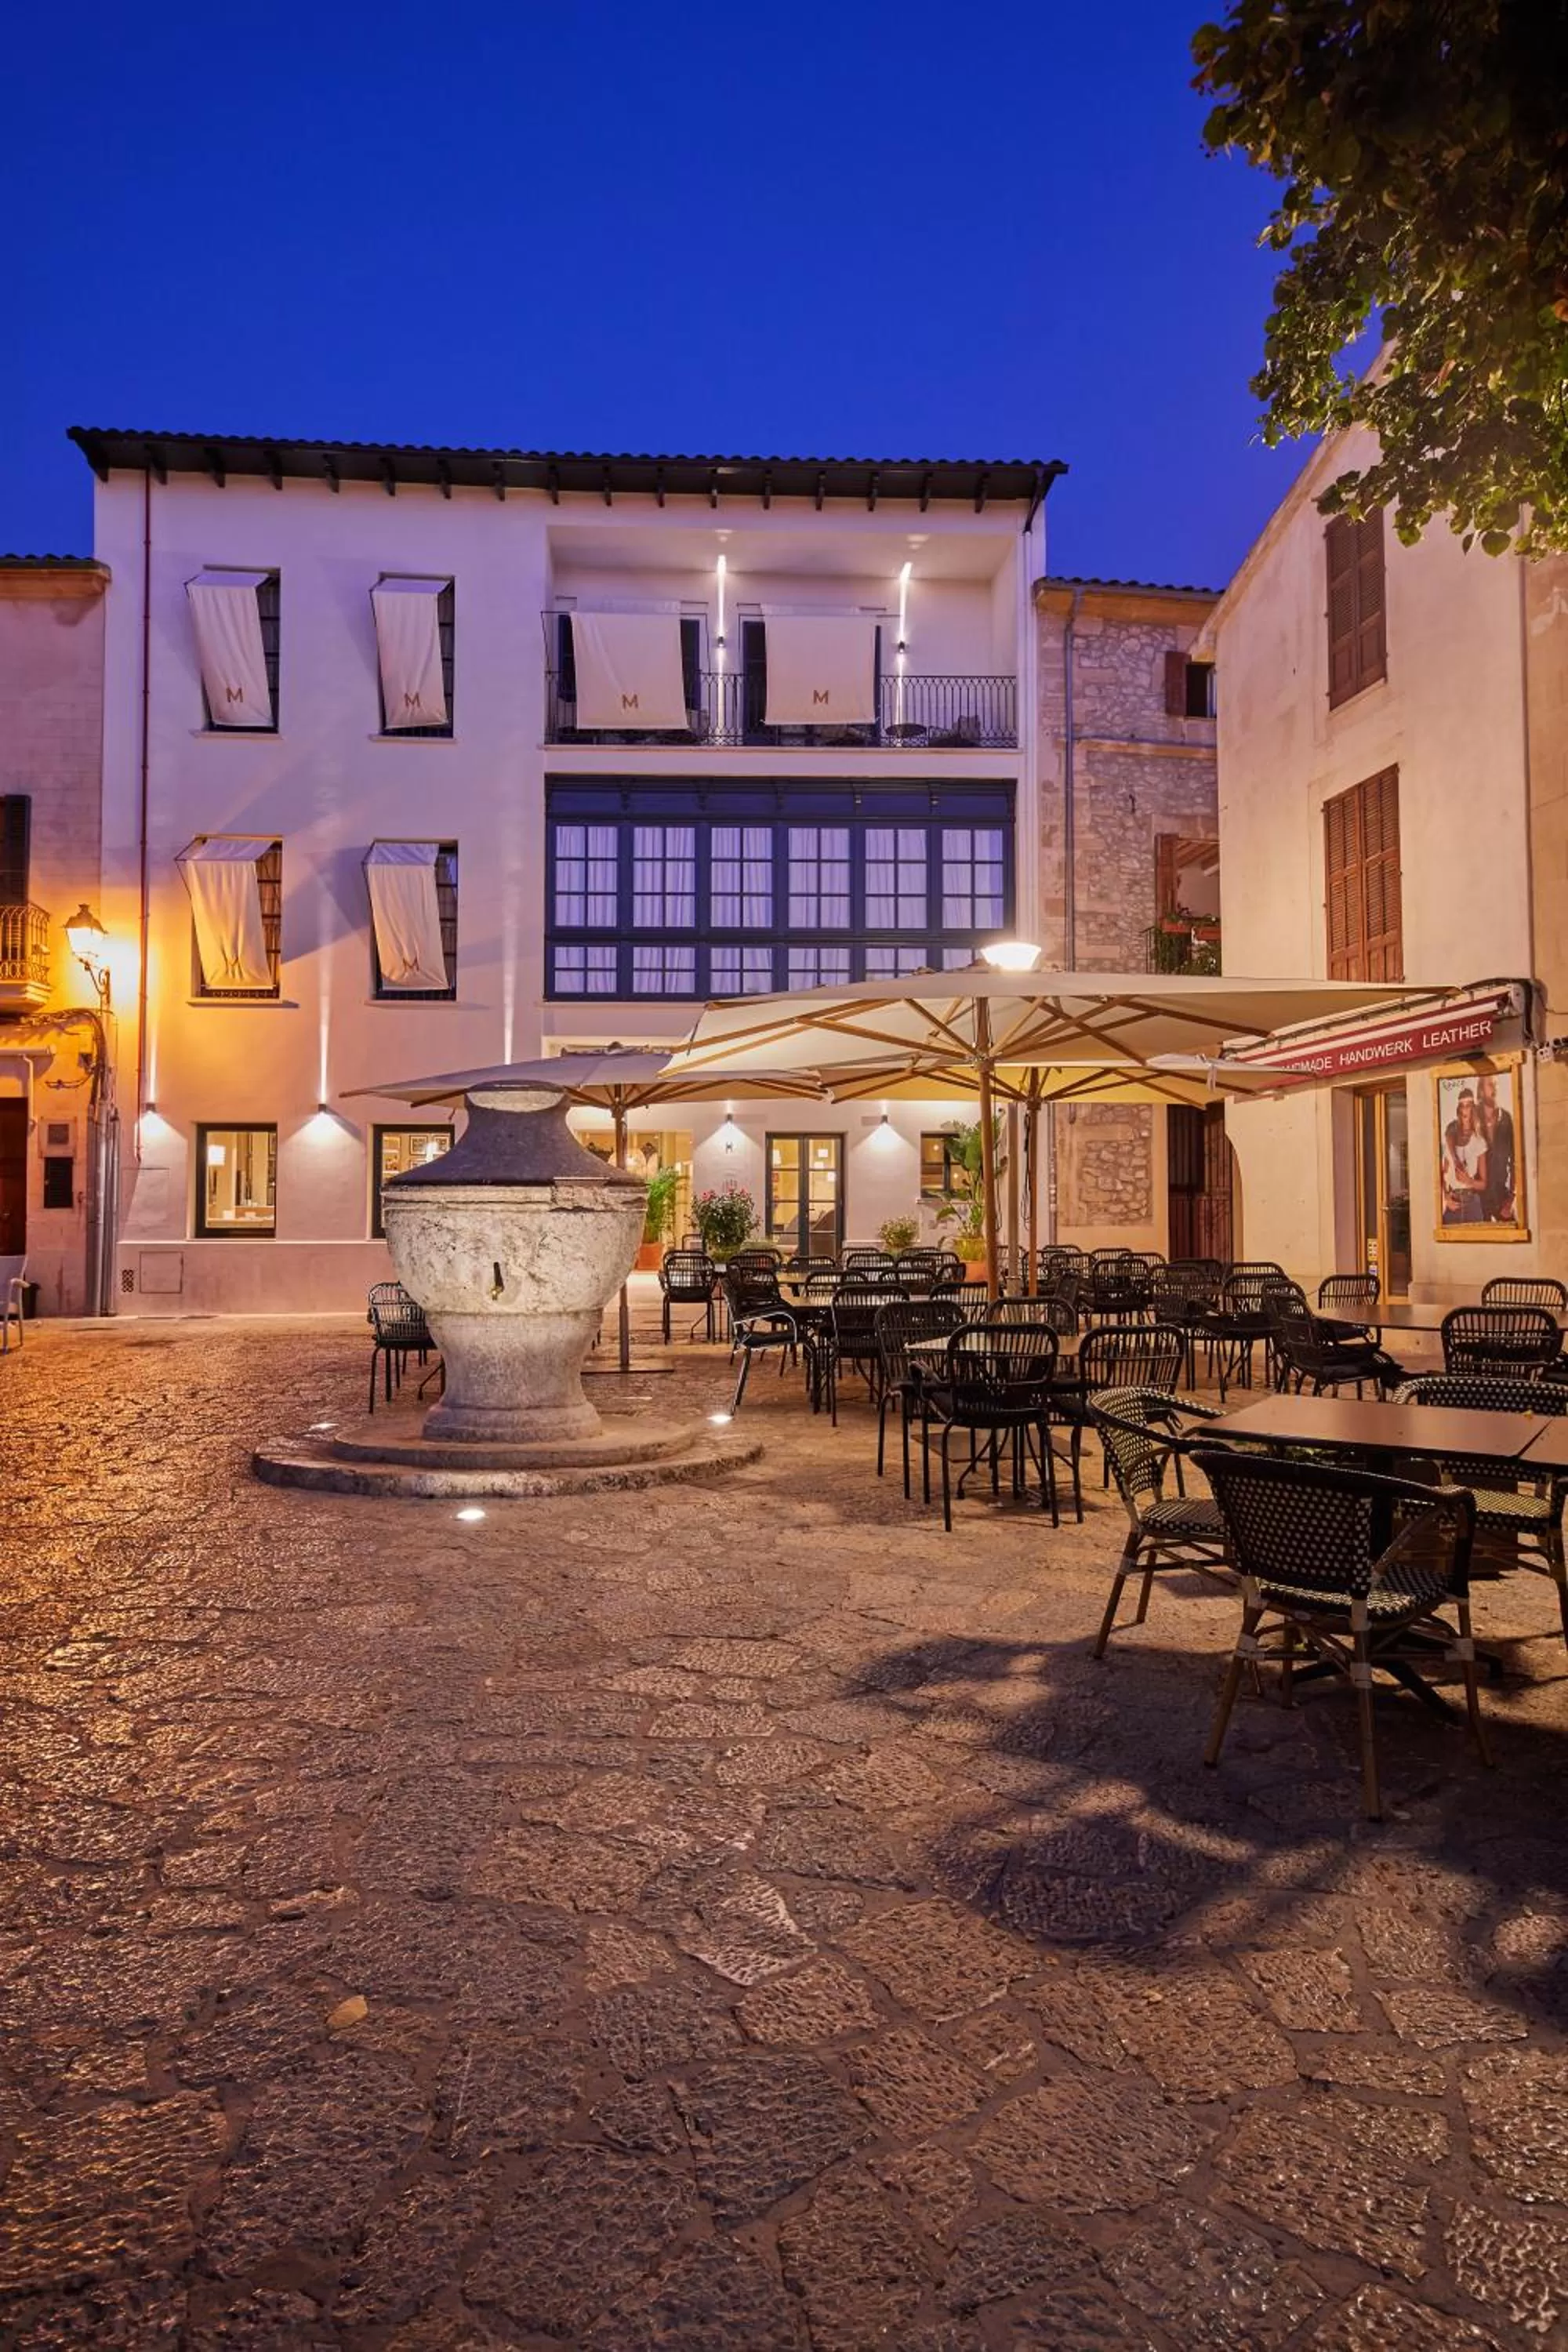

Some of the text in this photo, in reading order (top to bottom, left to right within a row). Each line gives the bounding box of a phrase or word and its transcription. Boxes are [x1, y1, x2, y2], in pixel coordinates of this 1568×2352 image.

[226, 687, 243, 703] M
[405, 692, 421, 708] M
[622, 694, 638, 710] M
[813, 689, 829, 705] M
[402, 956, 419, 972] M
[1282, 1020, 1492, 1072] MADE HANDWERK LEATHER
